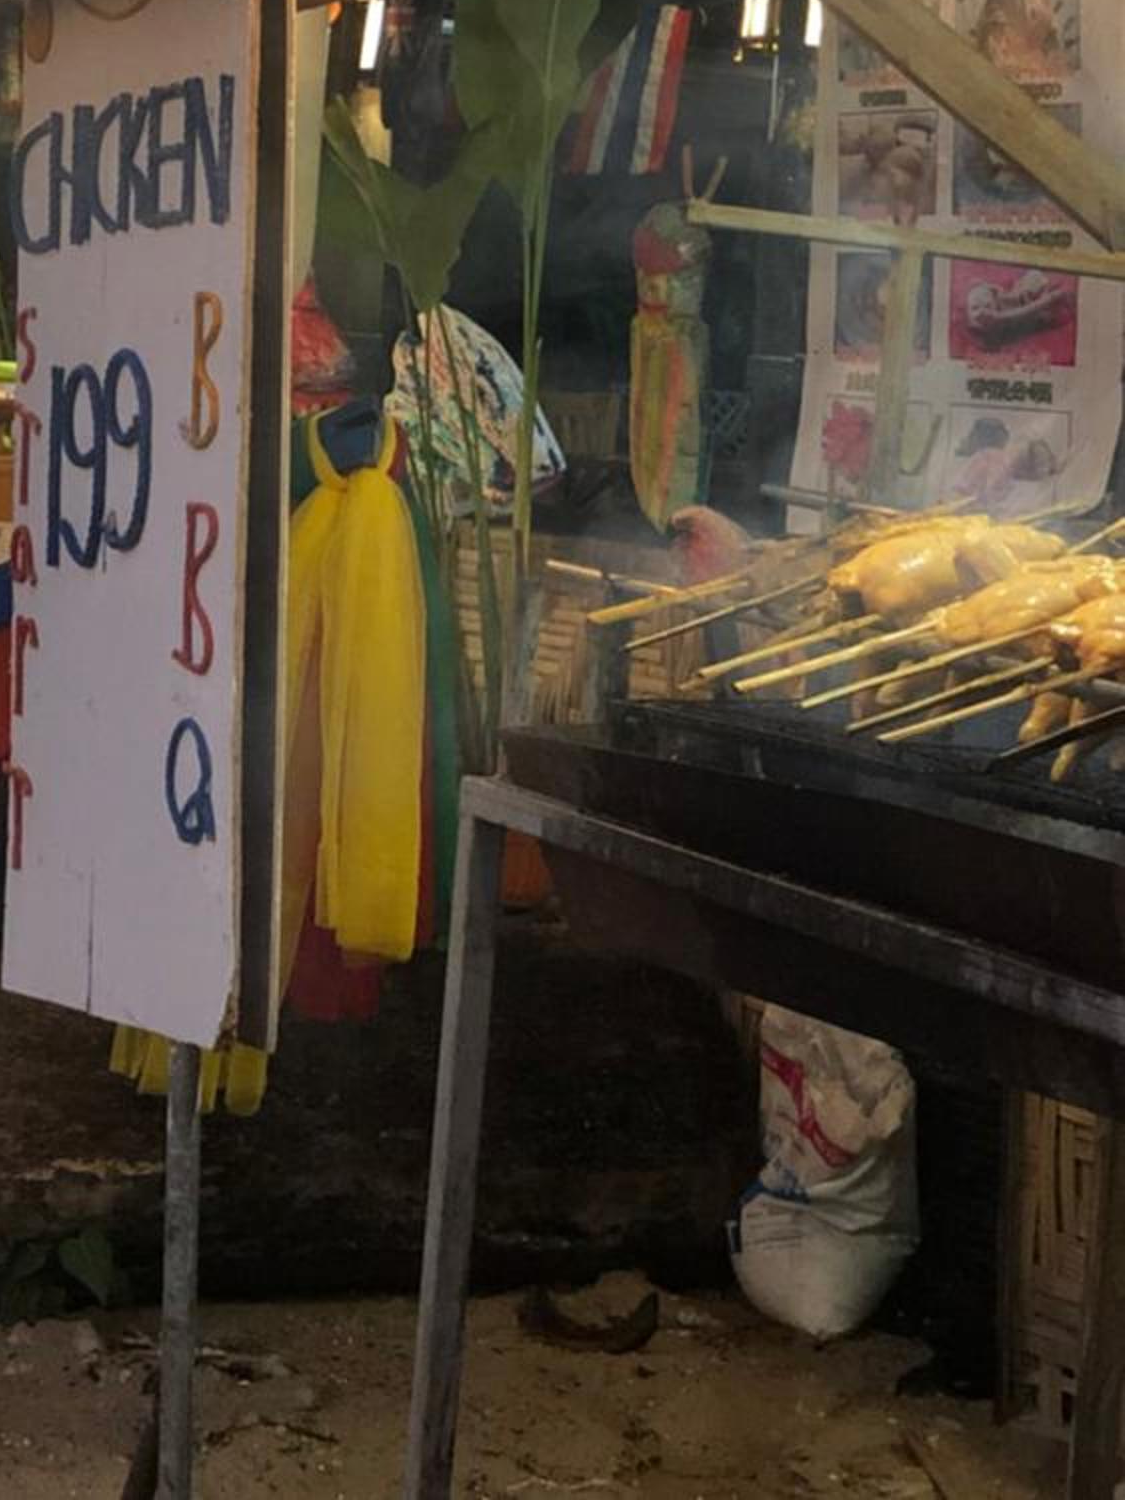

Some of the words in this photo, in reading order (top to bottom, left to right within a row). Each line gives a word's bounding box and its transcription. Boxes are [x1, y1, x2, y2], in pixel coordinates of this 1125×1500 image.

[10, 73, 235, 255] CHICKEN
[45, 347, 153, 569] 199
[166, 291, 223, 845] BBQ
